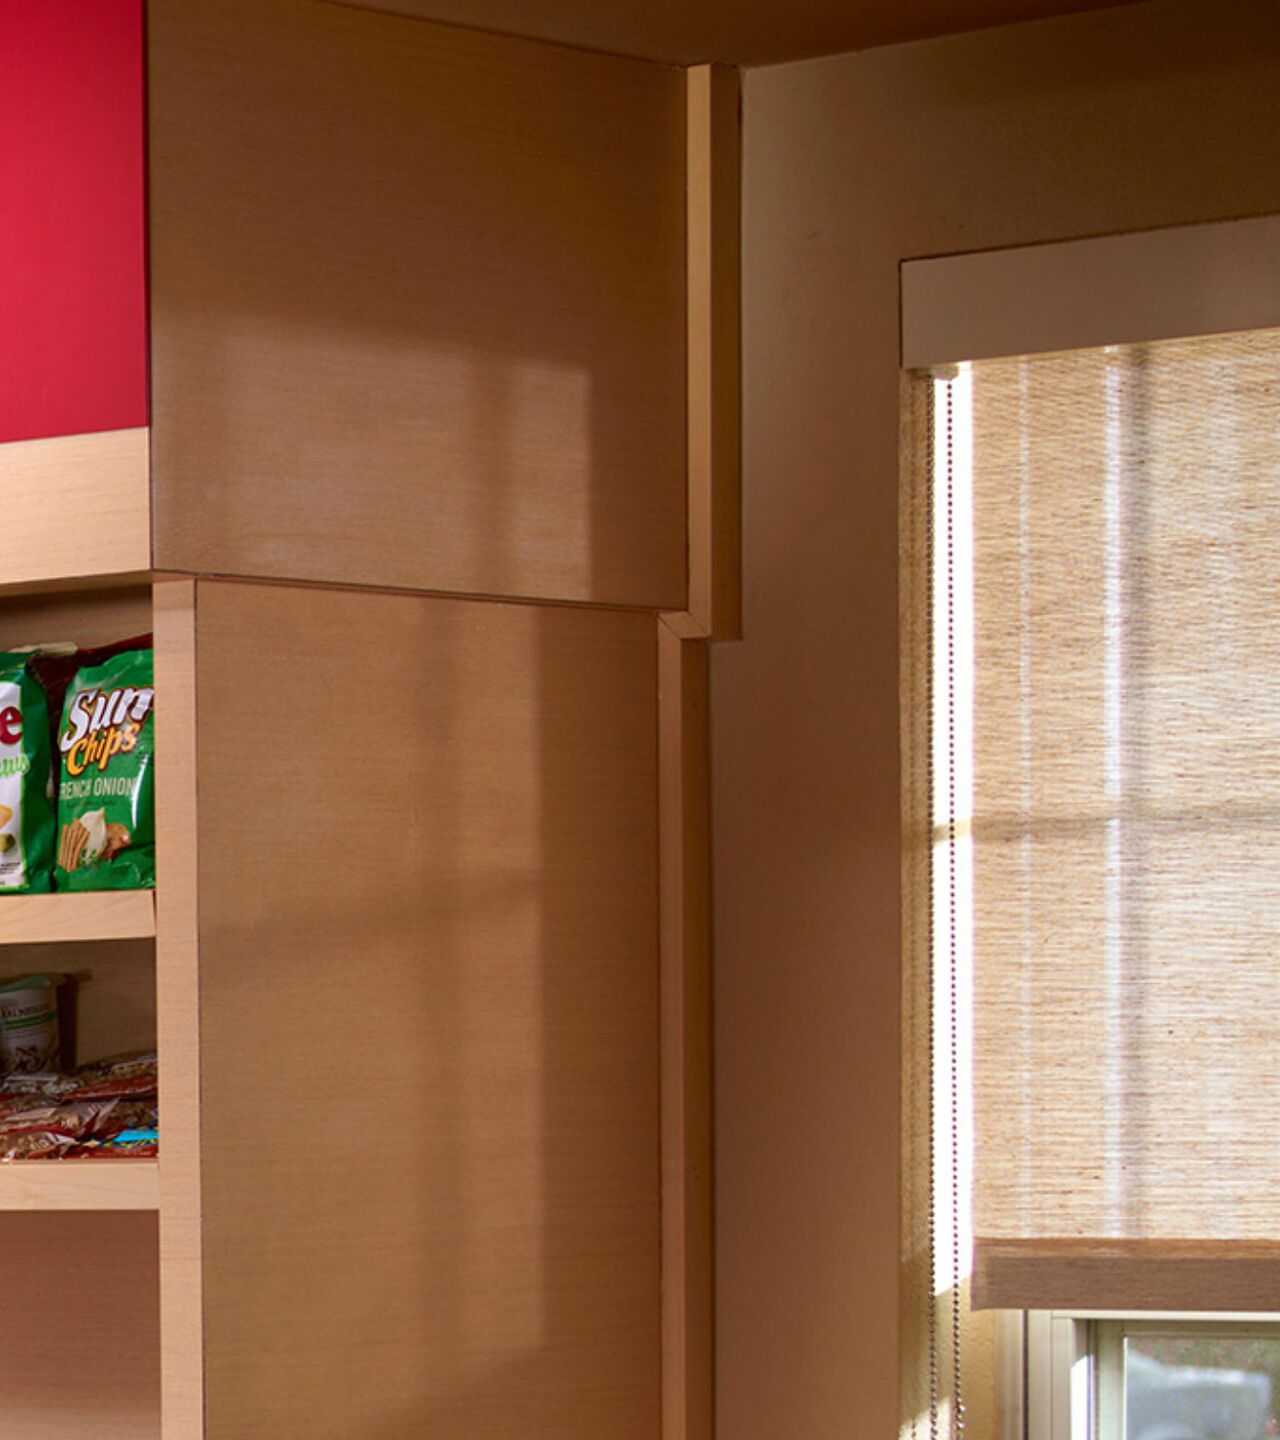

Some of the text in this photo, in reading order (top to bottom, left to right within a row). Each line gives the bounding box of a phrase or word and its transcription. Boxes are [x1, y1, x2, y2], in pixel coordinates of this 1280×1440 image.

[60, 688, 154, 753] Sun
[66, 721, 141, 776] Chips
[60, 782, 90, 800] RENCH
